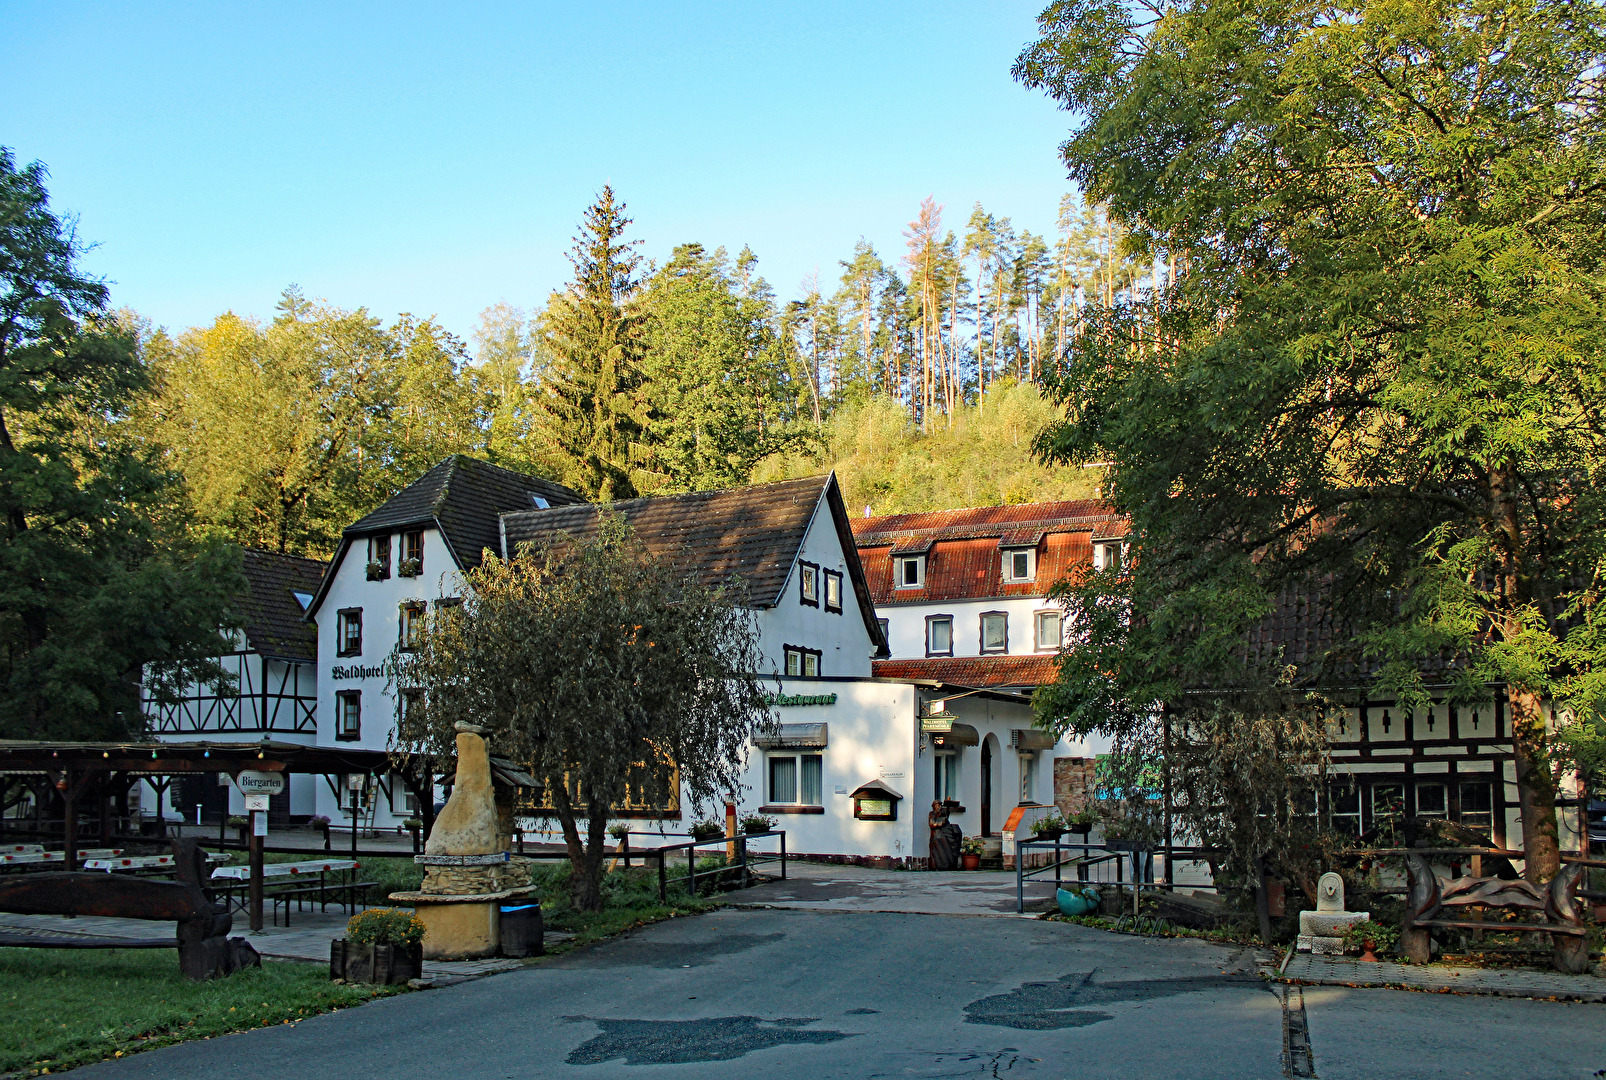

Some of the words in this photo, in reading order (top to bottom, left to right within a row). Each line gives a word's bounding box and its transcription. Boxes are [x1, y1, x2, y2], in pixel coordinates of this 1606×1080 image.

[332, 664, 384, 682] Waldhotel
[777, 692, 838, 706] Restaurant
[242, 776, 281, 789] Biergarten
